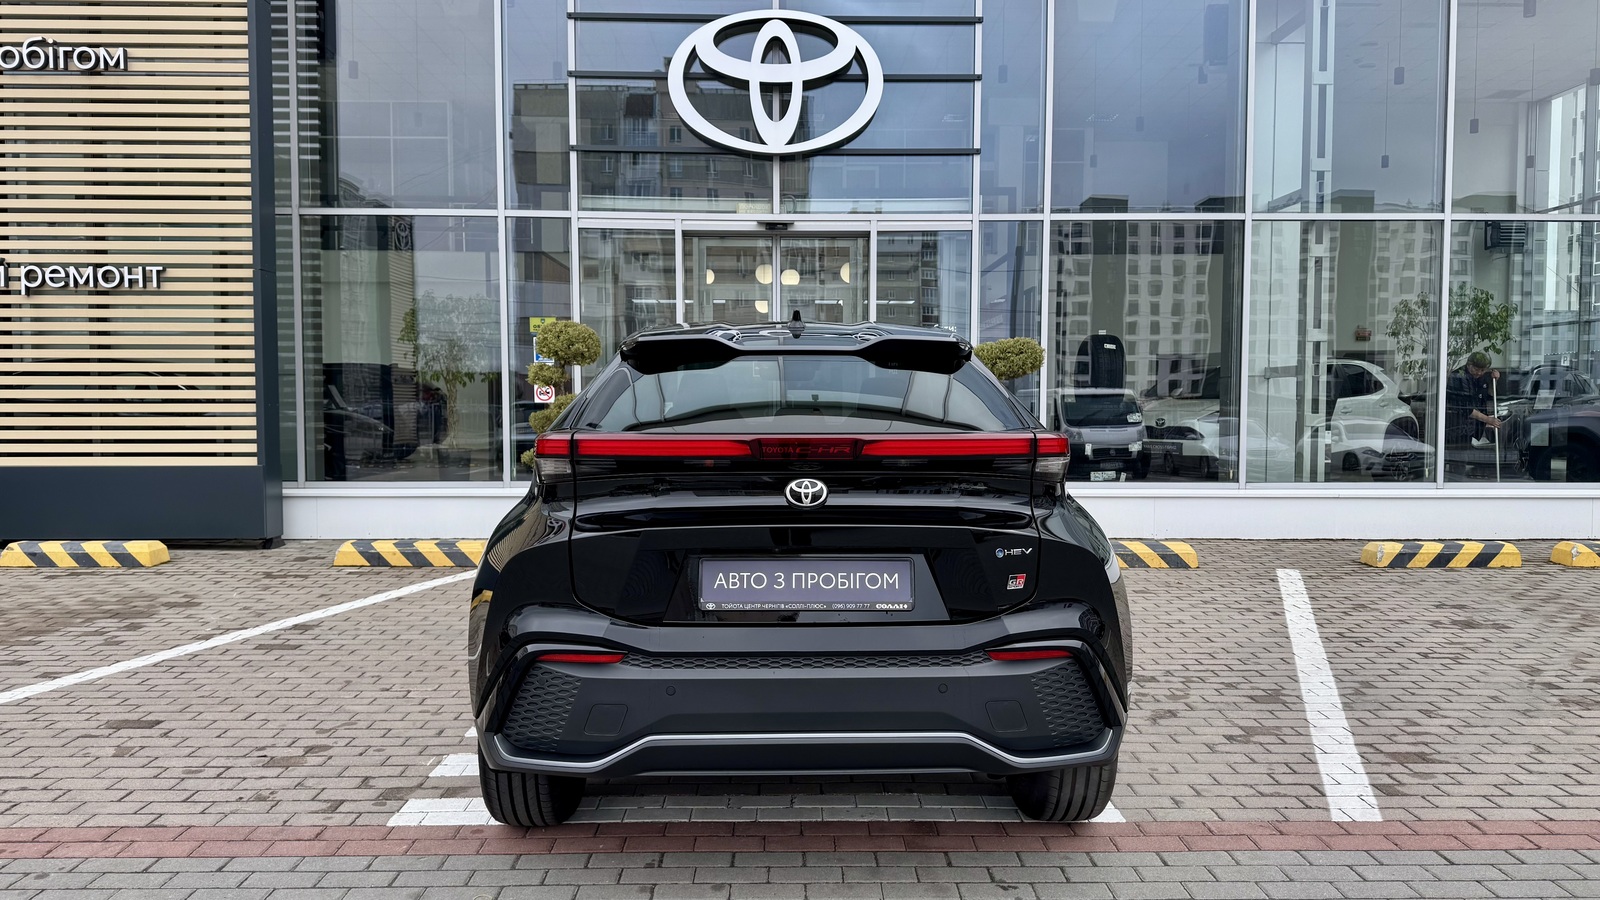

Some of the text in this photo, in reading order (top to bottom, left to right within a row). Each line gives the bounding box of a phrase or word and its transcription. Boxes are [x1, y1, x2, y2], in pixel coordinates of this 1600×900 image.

[20, 265, 165, 296] ремонт
[762, 446, 851, 454] TOYOTA C-HR
[1004, 548, 1033, 556] HEV
[713, 572, 899, 589] АВТО З ПРОБІГОМ
